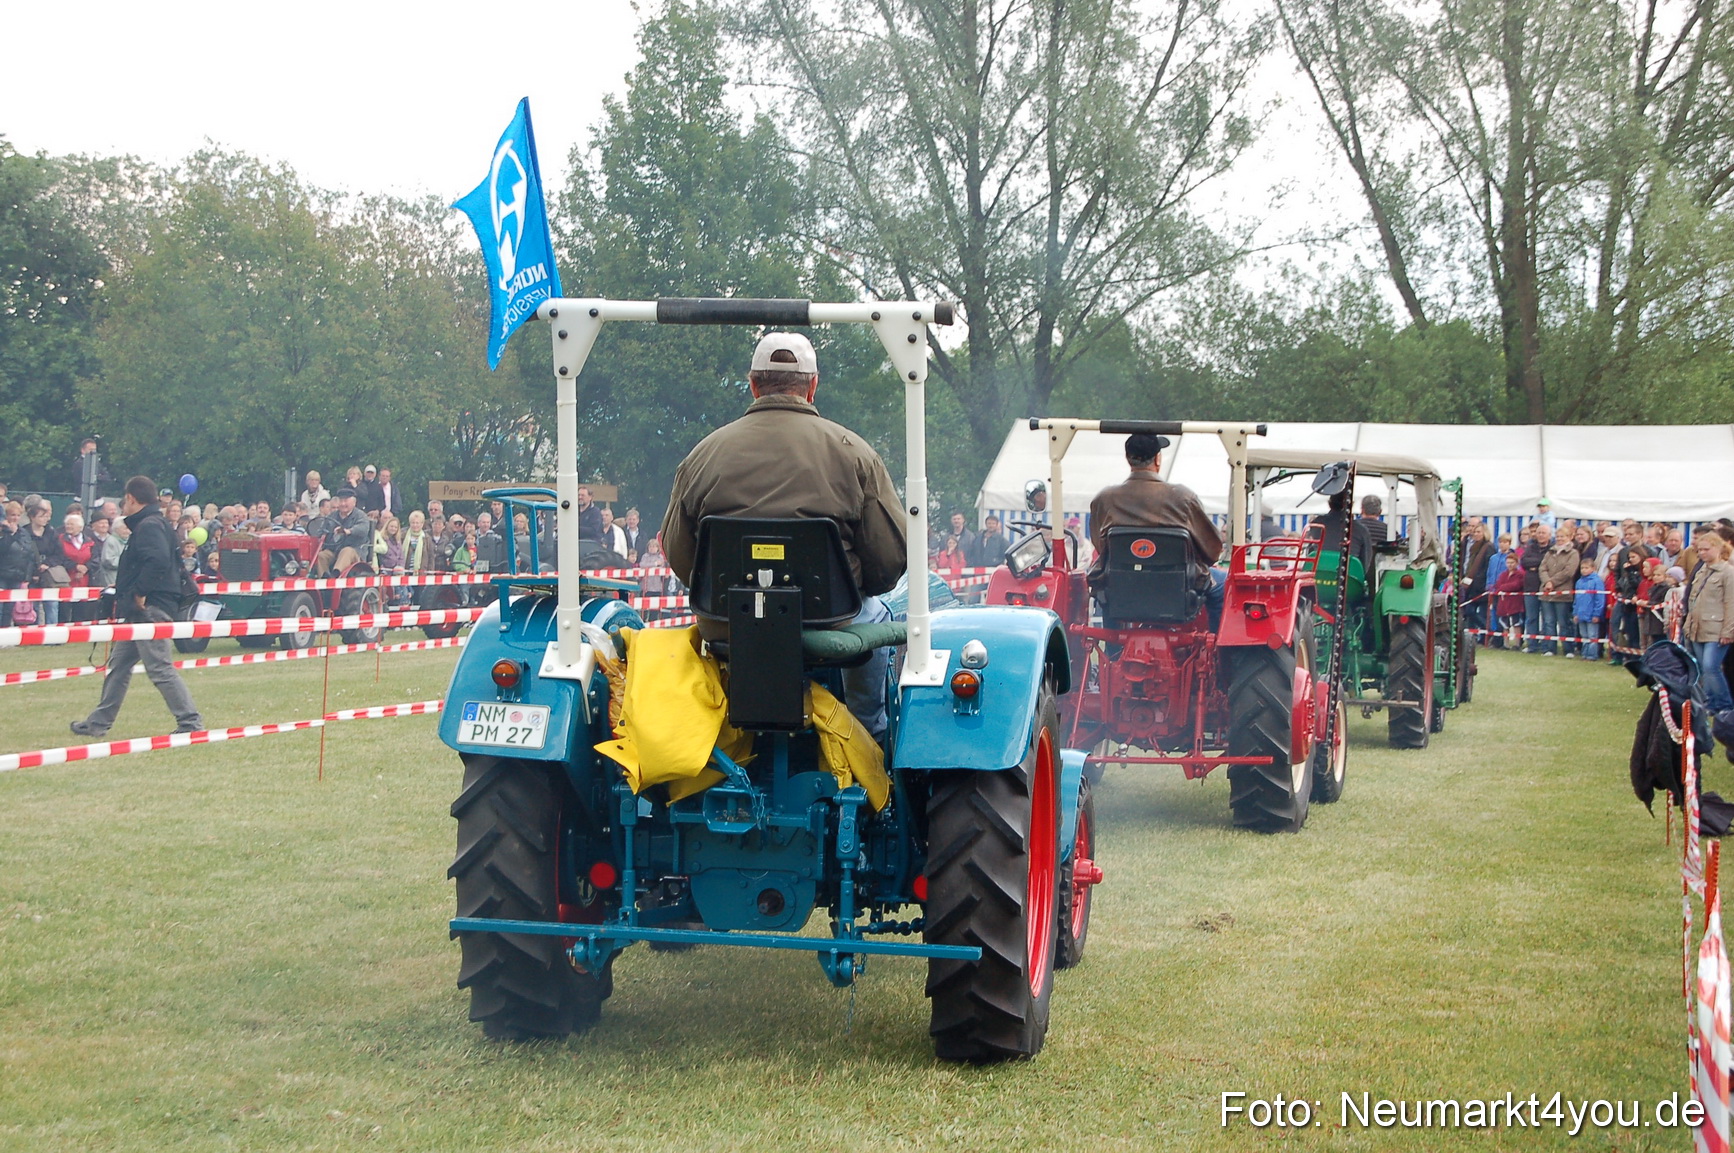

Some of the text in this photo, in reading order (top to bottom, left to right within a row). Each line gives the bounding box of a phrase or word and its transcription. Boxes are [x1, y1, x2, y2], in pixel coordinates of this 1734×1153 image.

[478, 705, 507, 723] NM
[471, 724, 533, 744] PM 27
